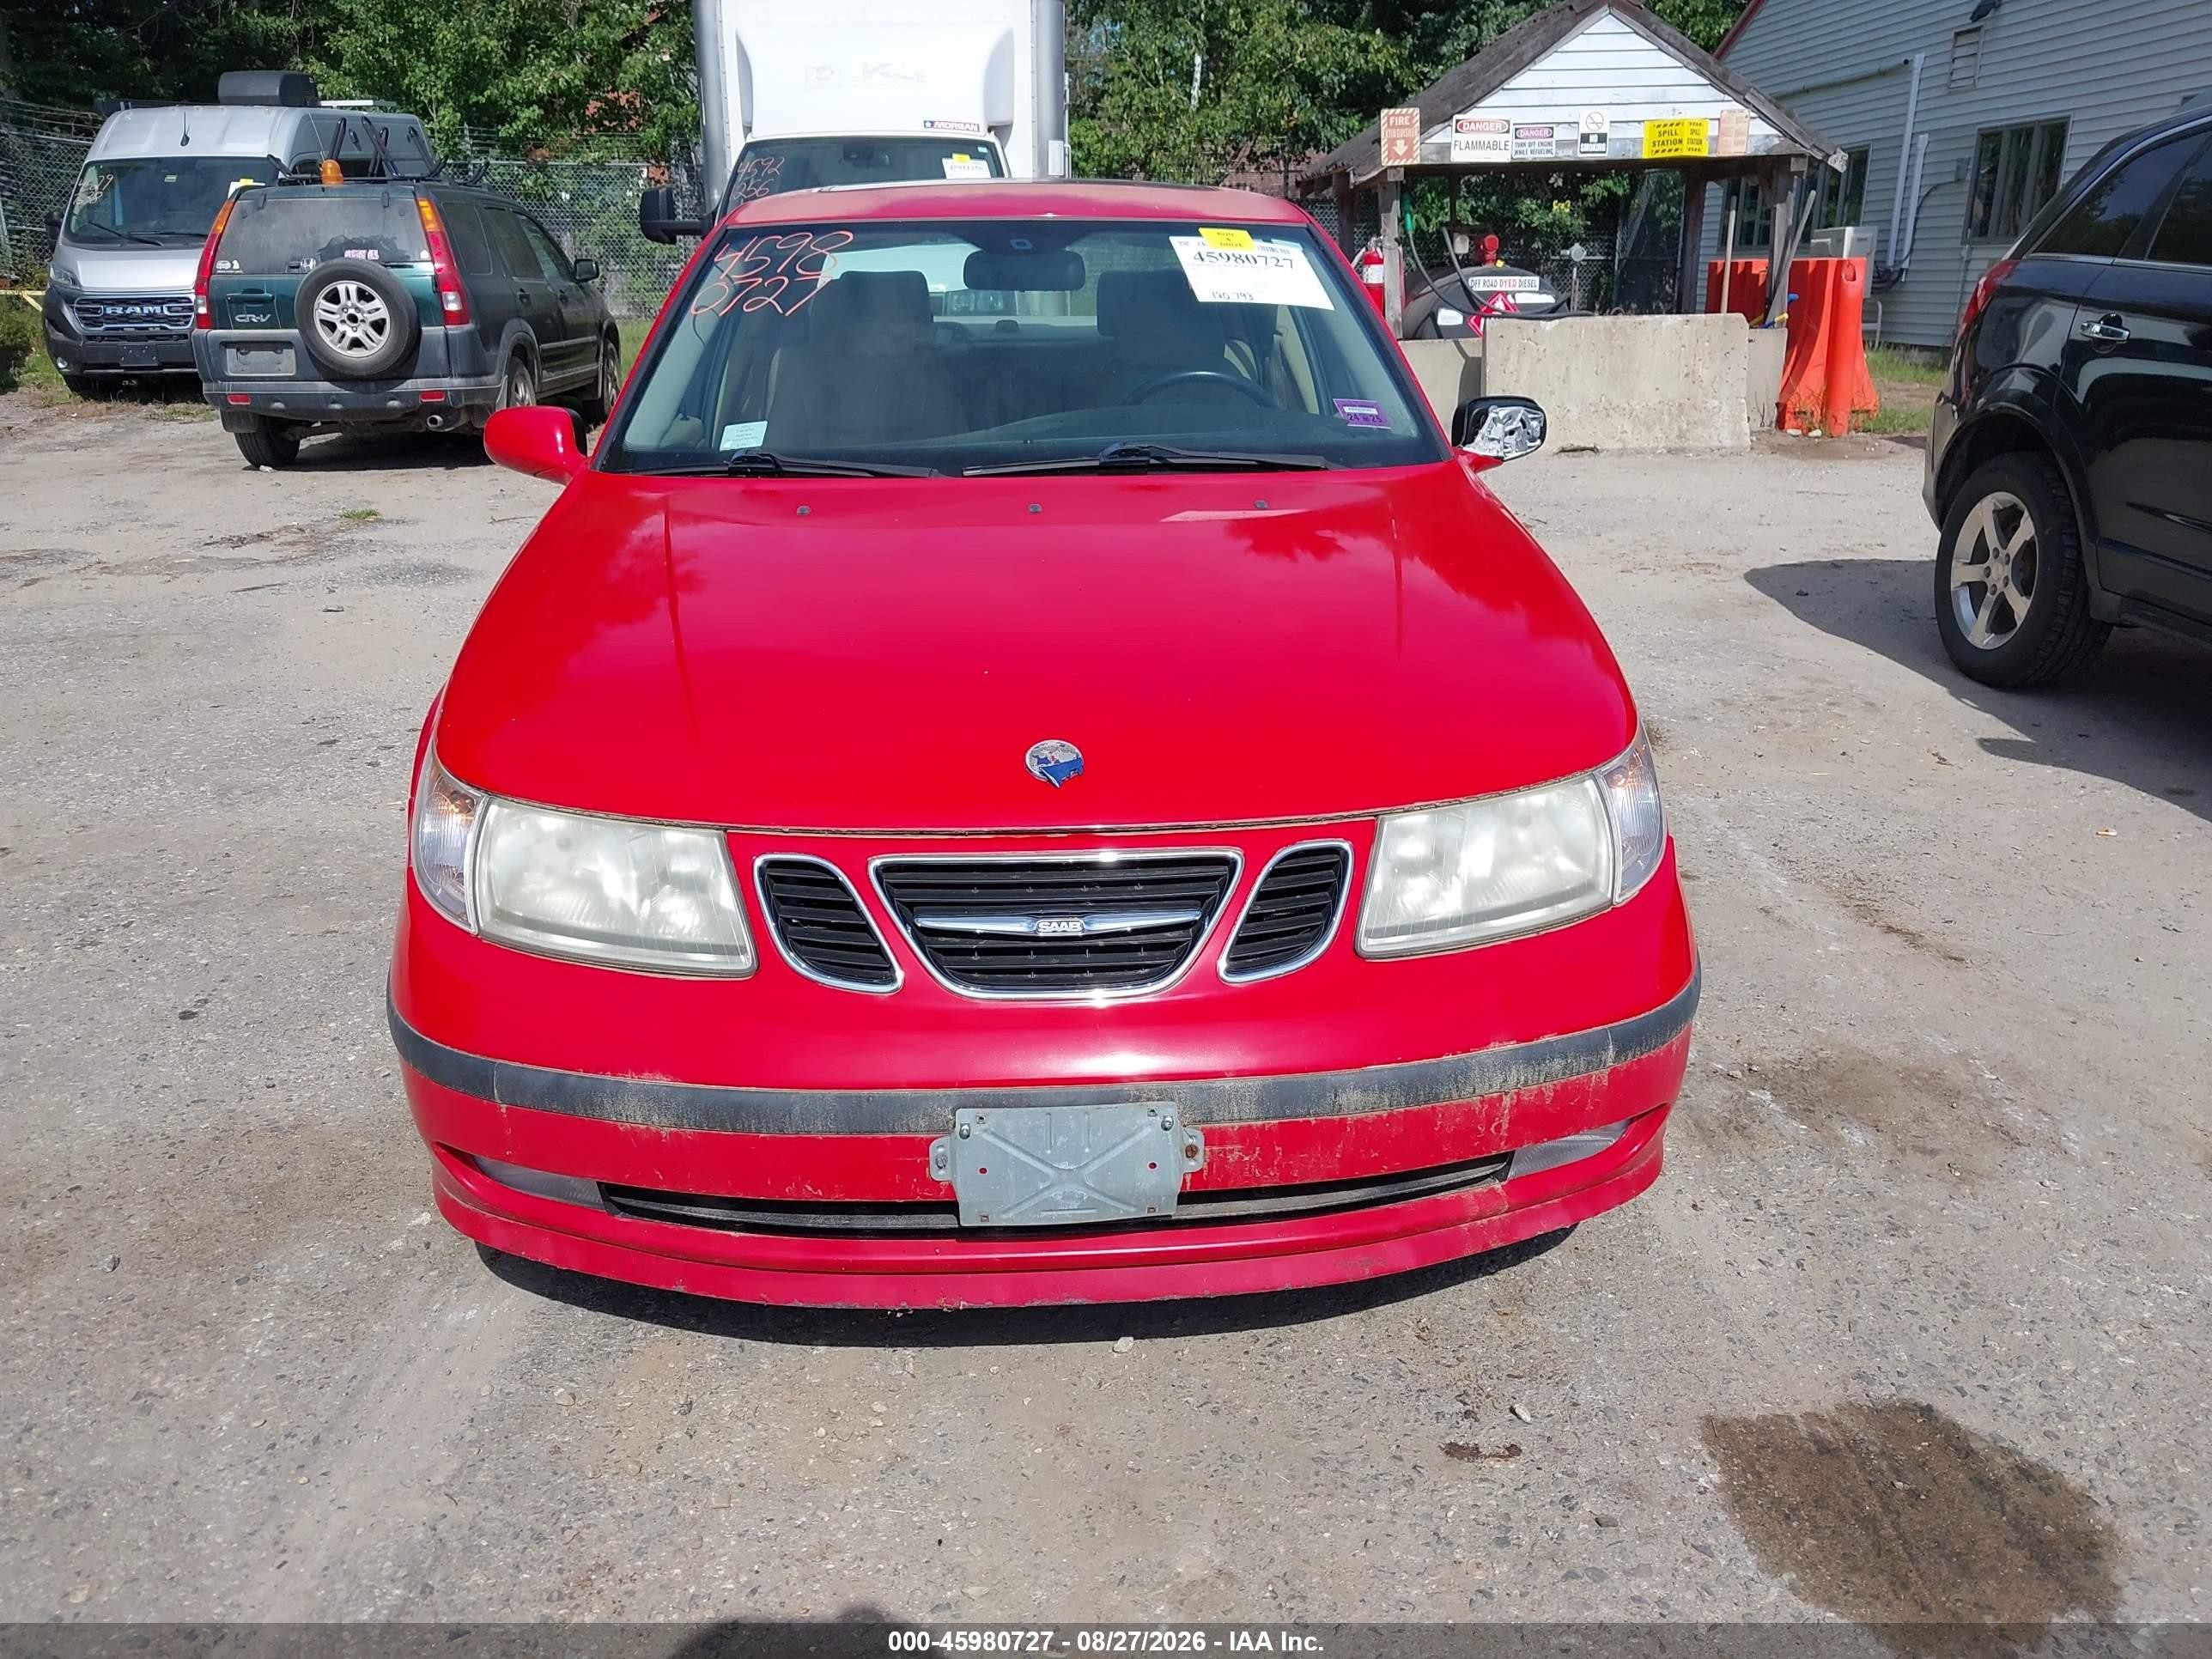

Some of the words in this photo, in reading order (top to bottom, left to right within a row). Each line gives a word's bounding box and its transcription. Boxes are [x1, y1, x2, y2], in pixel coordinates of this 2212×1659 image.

[1389, 116, 1410, 126] FIRE
[933, 121, 979, 132] MORGAN
[1462, 122, 1503, 131] DANGER
[1519, 129, 1550, 138] DANGER
[1589, 133, 1598, 143] NO
[1657, 129, 1678, 137] SPILL
[1454, 140, 1510, 151] FLAMMABLE
[1651, 137, 1683, 148] STATION
[1580, 143, 1607, 153] SMOKING
[738, 156, 785, 182] 4592
[714, 231, 854, 279] 4598
[1194, 251, 1294, 269] 45980727
[1471, 279, 1481, 289] OFF
[1483, 279, 1498, 289] ROAD
[1499, 279, 1517, 289] DYED
[1518, 279, 1537, 289] DIESEL
[690, 276, 834, 317] 0727
[106, 306, 161, 314] RAM
[234, 313, 271, 323] CR-V
[1346, 413, 1360, 422] 24
[1038, 921, 1082, 933] SAAB
